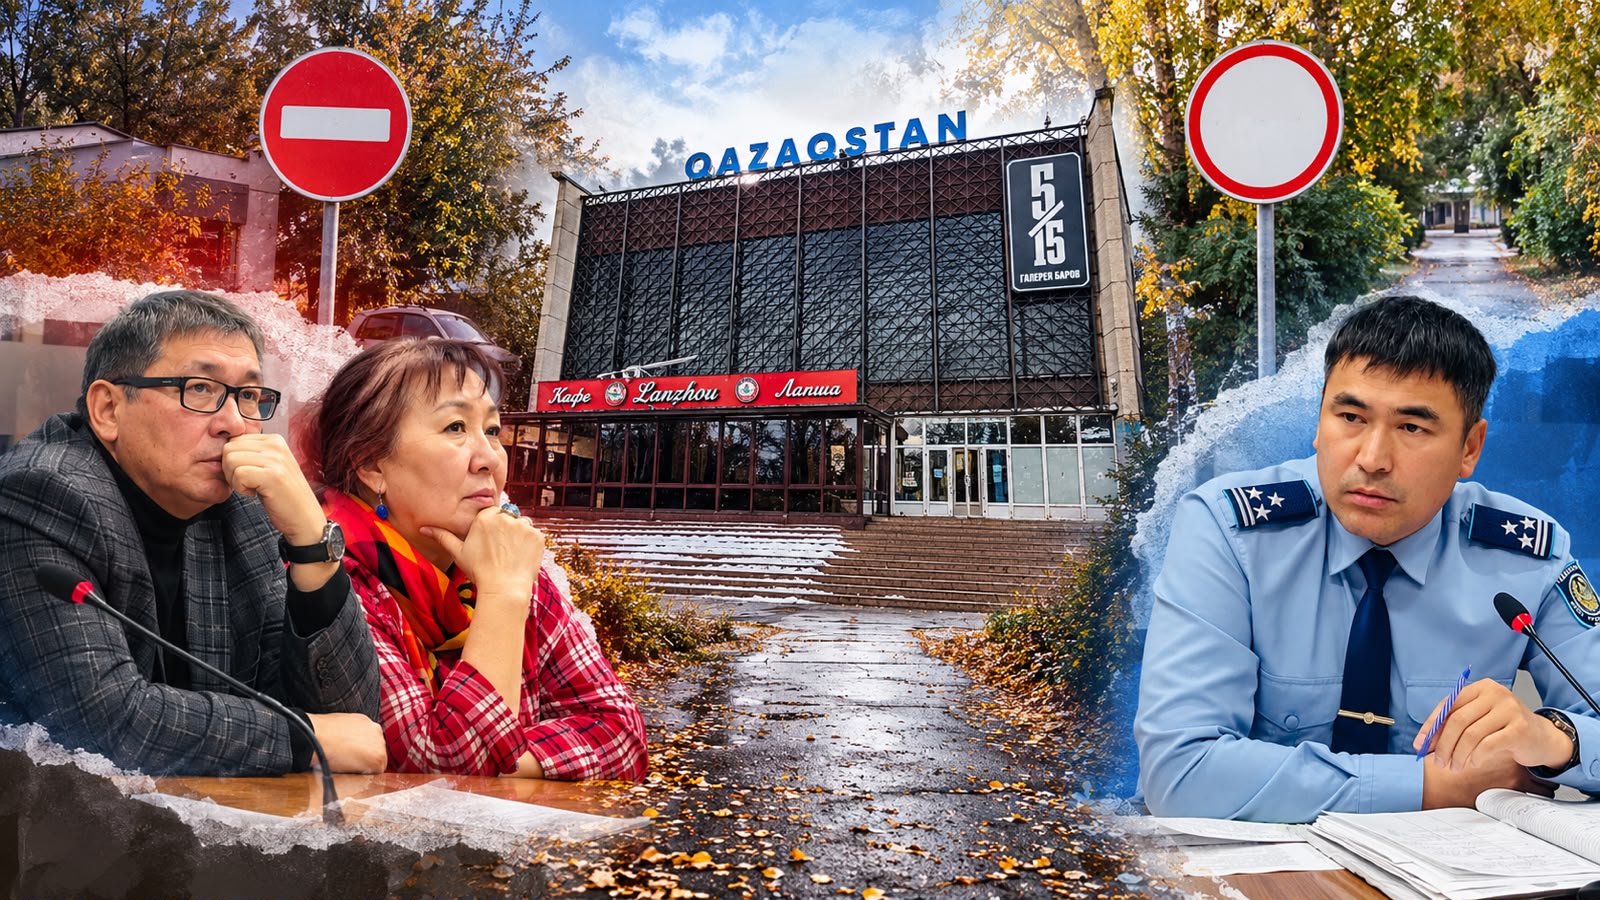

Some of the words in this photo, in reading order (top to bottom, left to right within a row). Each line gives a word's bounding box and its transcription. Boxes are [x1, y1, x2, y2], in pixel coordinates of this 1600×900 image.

[685, 110, 967, 180] QAZAQSTAN
[1020, 272, 1053, 283] ГАЛЕРЕЯ
[1055, 270, 1080, 280] БАРОВ
[548, 387, 592, 408] Кафе
[632, 380, 719, 406] Lanzhou
[774, 378, 842, 398] Лапша
